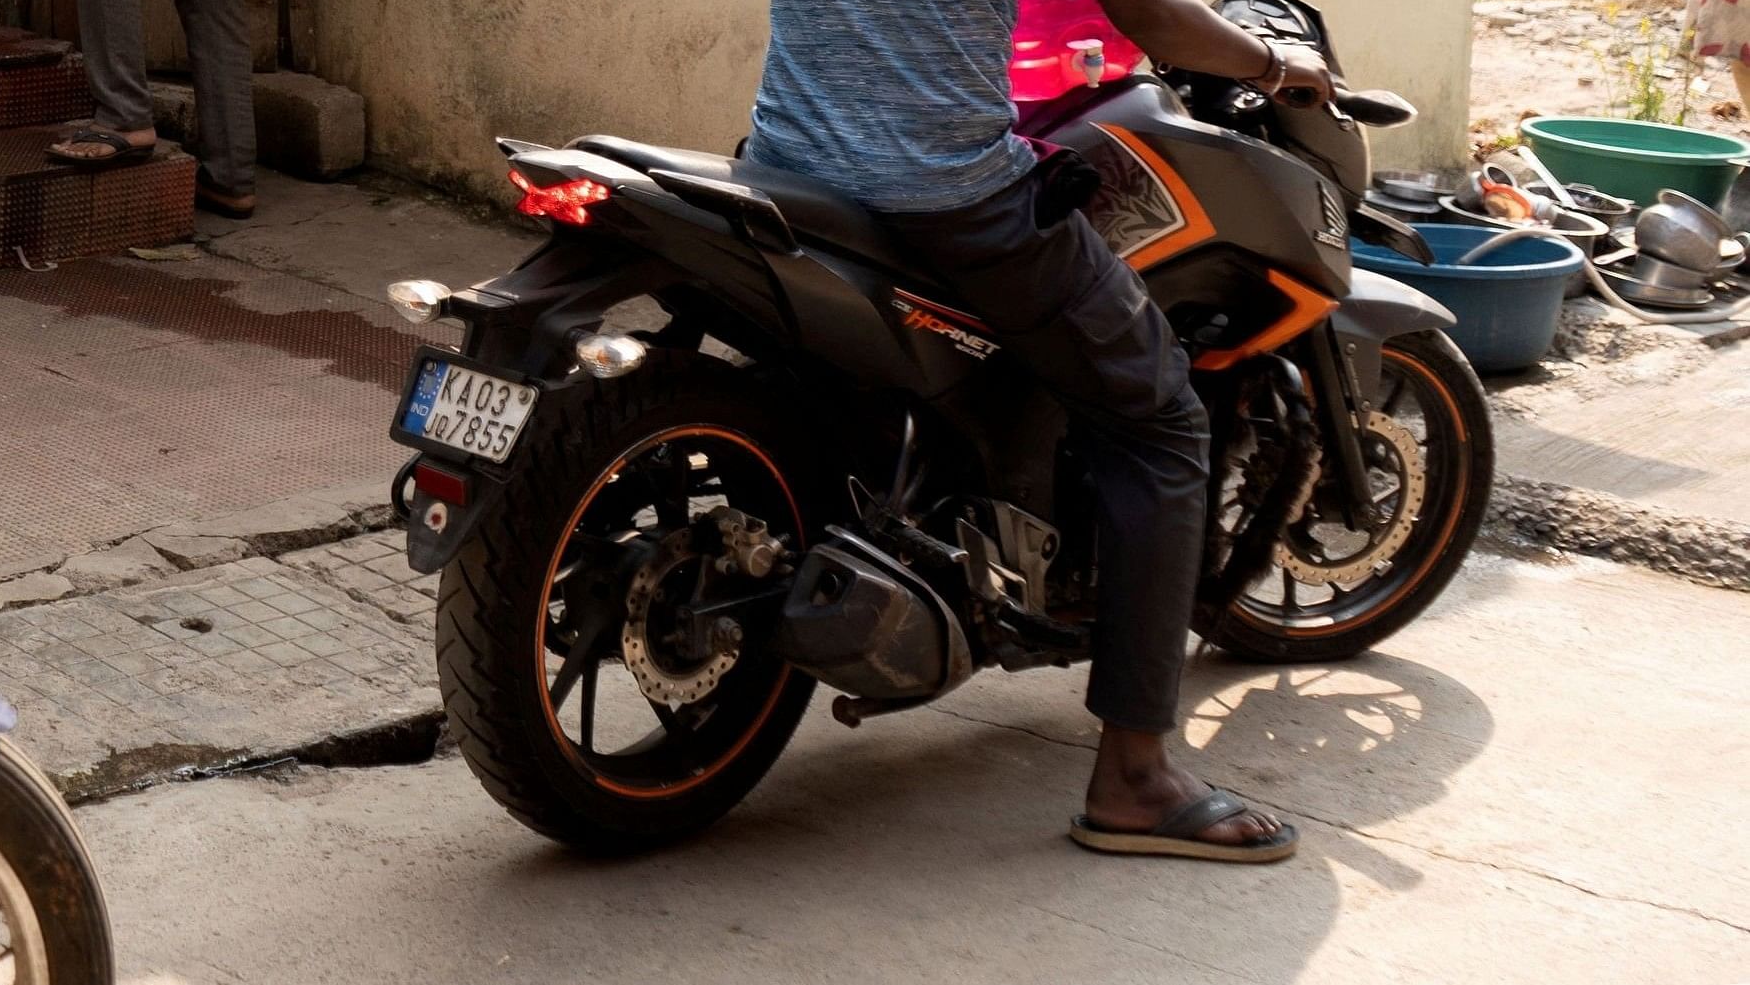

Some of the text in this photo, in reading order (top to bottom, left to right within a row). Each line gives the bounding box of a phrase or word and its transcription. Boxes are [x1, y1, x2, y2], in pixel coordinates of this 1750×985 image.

[903, 309, 1002, 355] HORNET
[410, 403, 429, 417] IND
[440, 368, 511, 417] KA03
